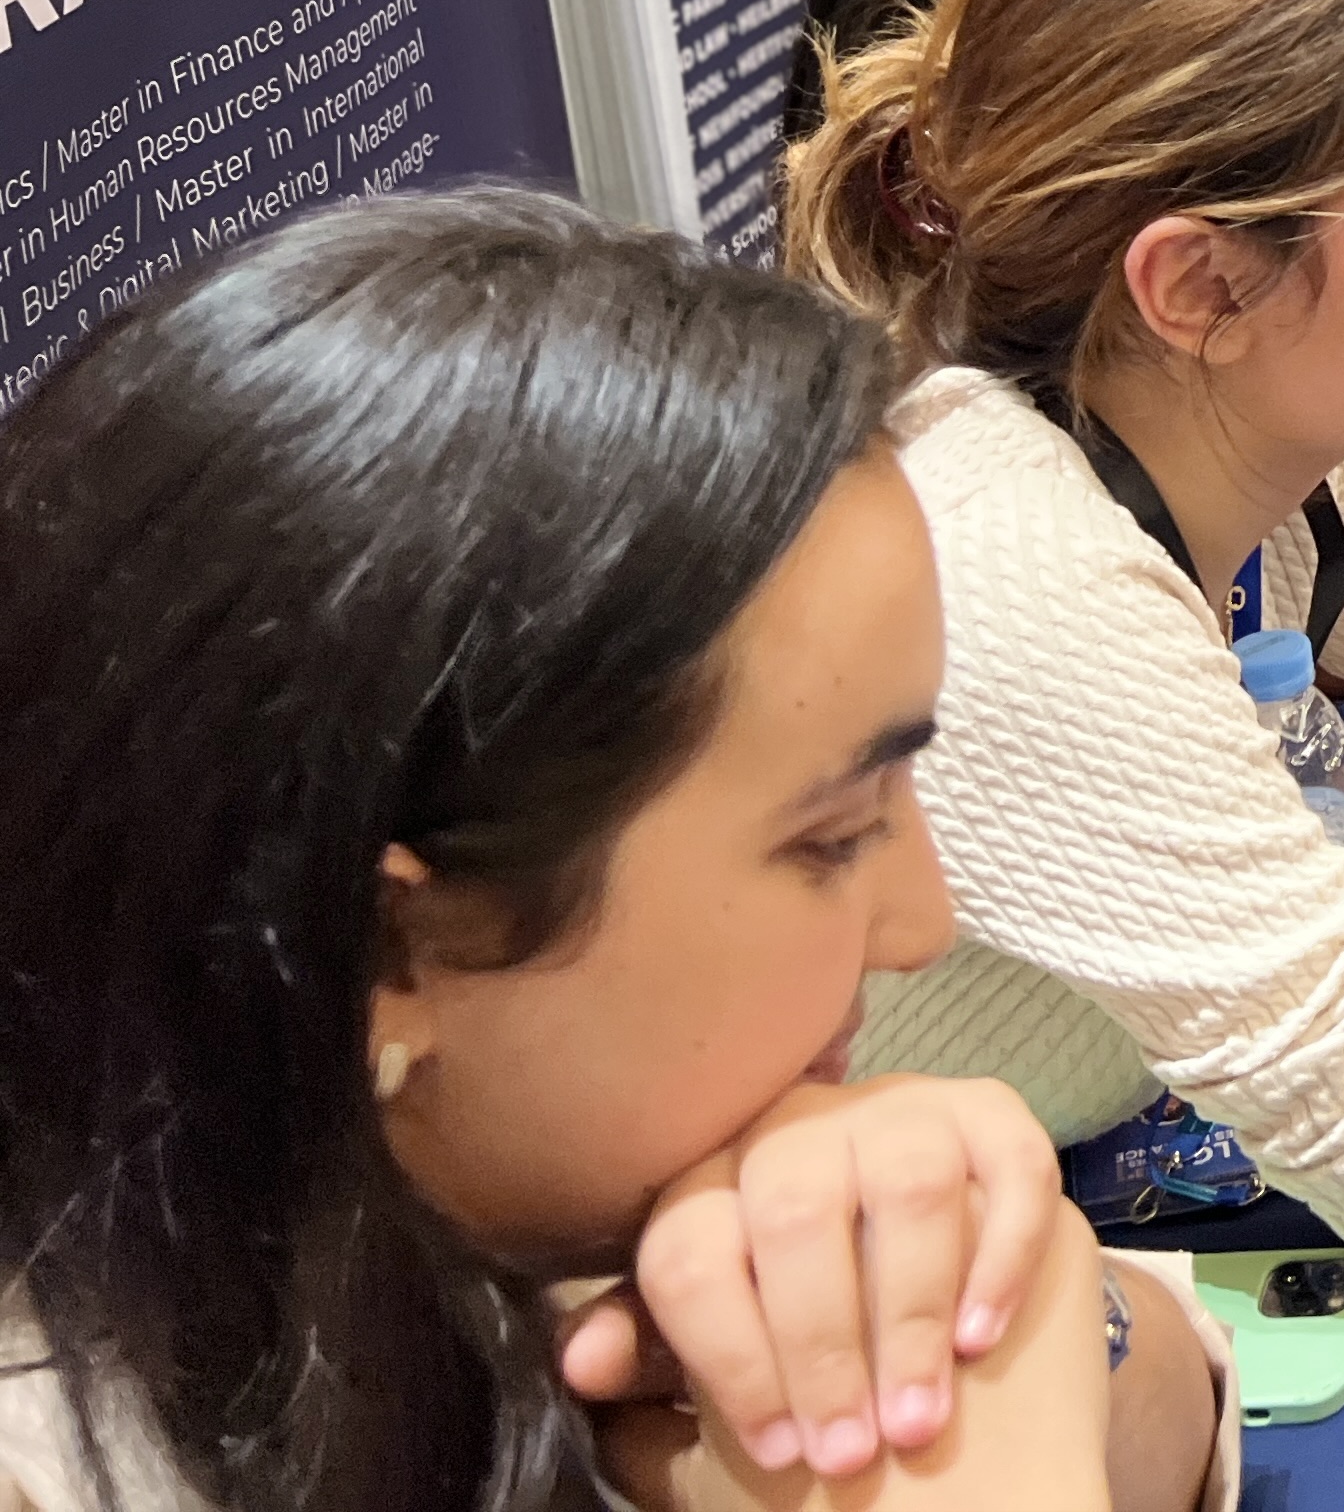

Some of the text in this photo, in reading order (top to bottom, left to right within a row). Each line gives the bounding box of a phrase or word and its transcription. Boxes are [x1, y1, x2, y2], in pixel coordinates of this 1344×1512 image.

[18, 227, 46, 265] in
[50, 157, 135, 243] Human
[136, 75, 284, 175] Resources
[22, 224, 126, 327] Business
[155, 144, 254, 223] Master
[266, 125, 294, 160] in
[302, 26, 427, 138] International
[57, 94, 131, 174] Master
[136, 79, 164, 114] in
[169, 19, 285, 96] Finance
[191, 159, 330, 257] Marketing
[348, 94, 409, 163] Master
[414, 81, 434, 113] in
[363, 133, 440, 202] Manage-
